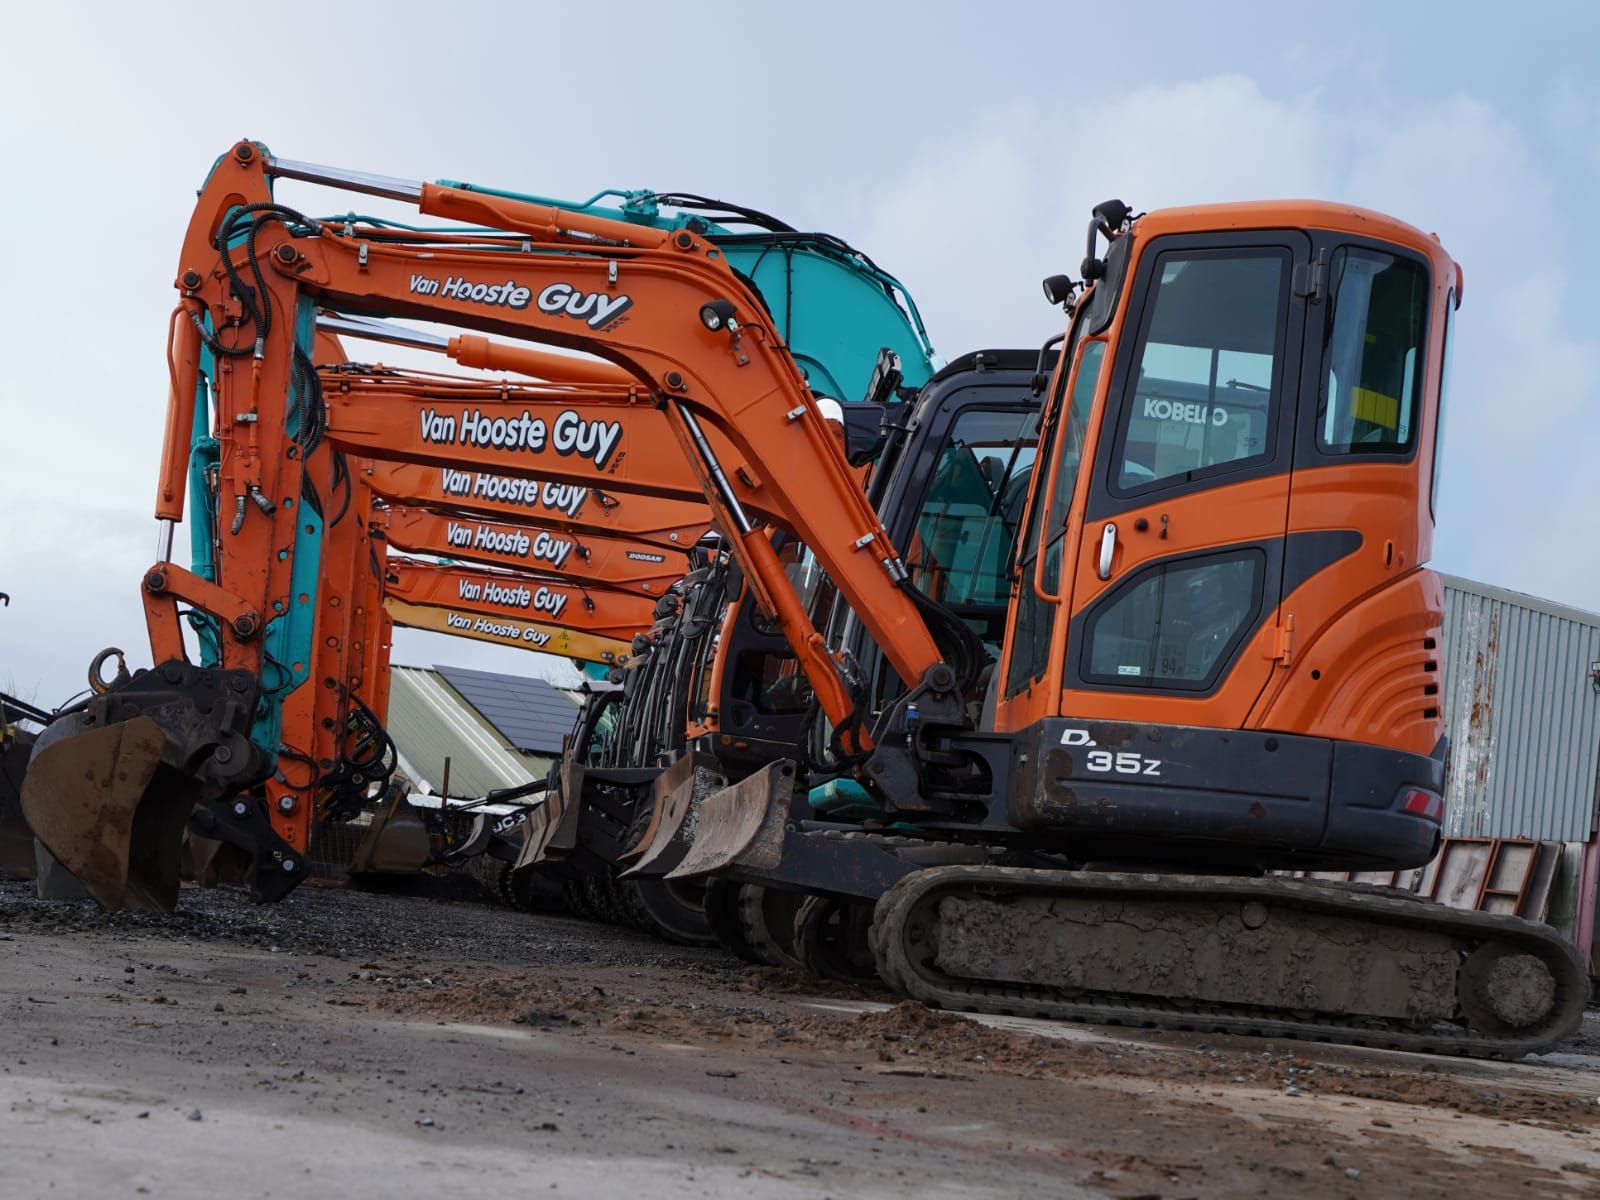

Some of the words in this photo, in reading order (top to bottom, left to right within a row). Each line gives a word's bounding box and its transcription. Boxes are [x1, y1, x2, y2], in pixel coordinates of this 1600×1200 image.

[410, 274, 439, 297] Van
[441, 276, 531, 307] Hooste
[537, 283, 632, 329] Guy
[420, 408, 456, 444] Van
[459, 409, 547, 454] Hooste
[552, 410, 623, 471] Guy
[441, 468, 471, 494] Van
[474, 473, 538, 502] Hooste
[542, 481, 588, 518] Guy
[447, 522, 472, 545] Van
[474, 525, 530, 555] Hooste
[533, 532, 572, 569] Guy
[628, 552, 662, 562] DOOSAN
[459, 579, 482, 600] Van
[482, 581, 531, 607] Hooste
[534, 587, 568, 619] Guy
[447, 612, 471, 630] Van
[473, 618, 521, 640] Hooste
[522, 629, 551, 647] Guy
